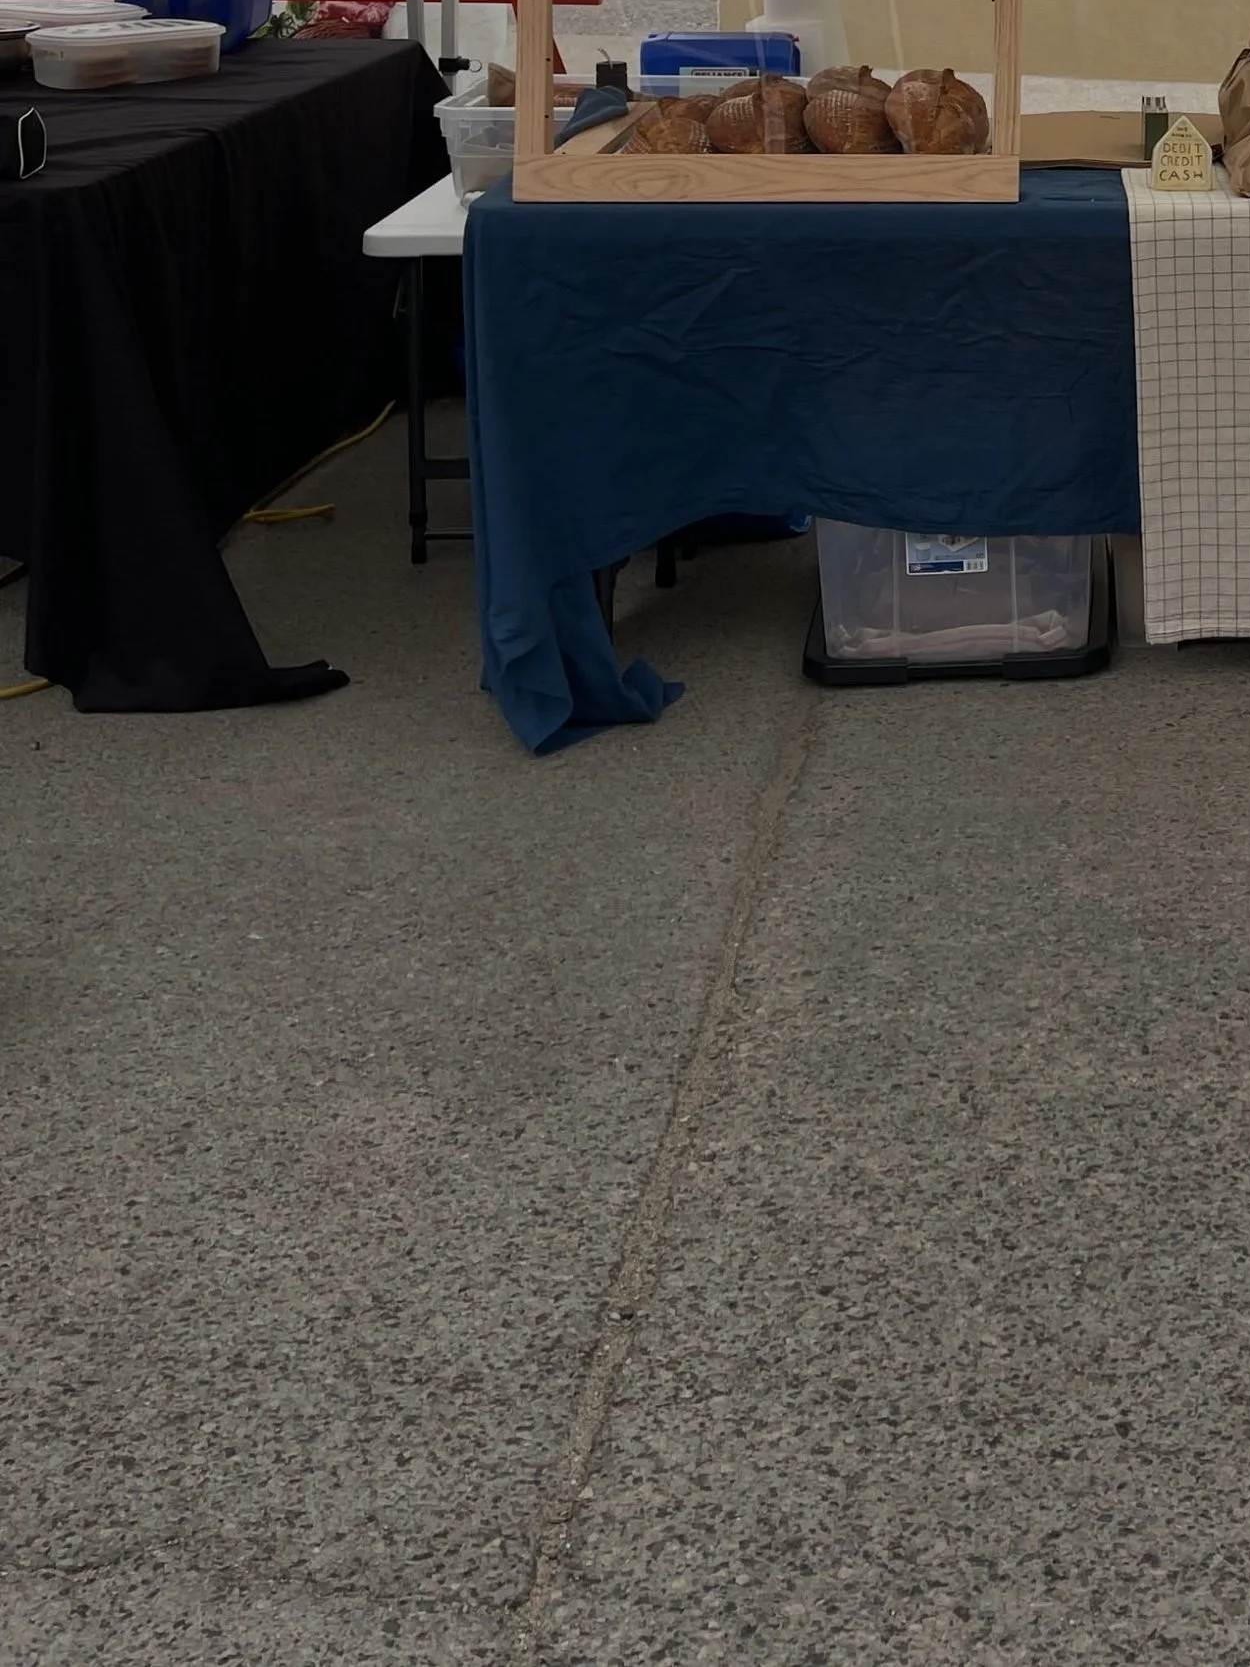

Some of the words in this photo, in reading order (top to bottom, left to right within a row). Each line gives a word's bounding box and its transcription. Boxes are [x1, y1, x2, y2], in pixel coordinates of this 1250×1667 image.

[1163, 143, 1202, 154] DEBIT
[1160, 155, 1203, 166] CREDIT
[1159, 170, 1203, 181] CASH
